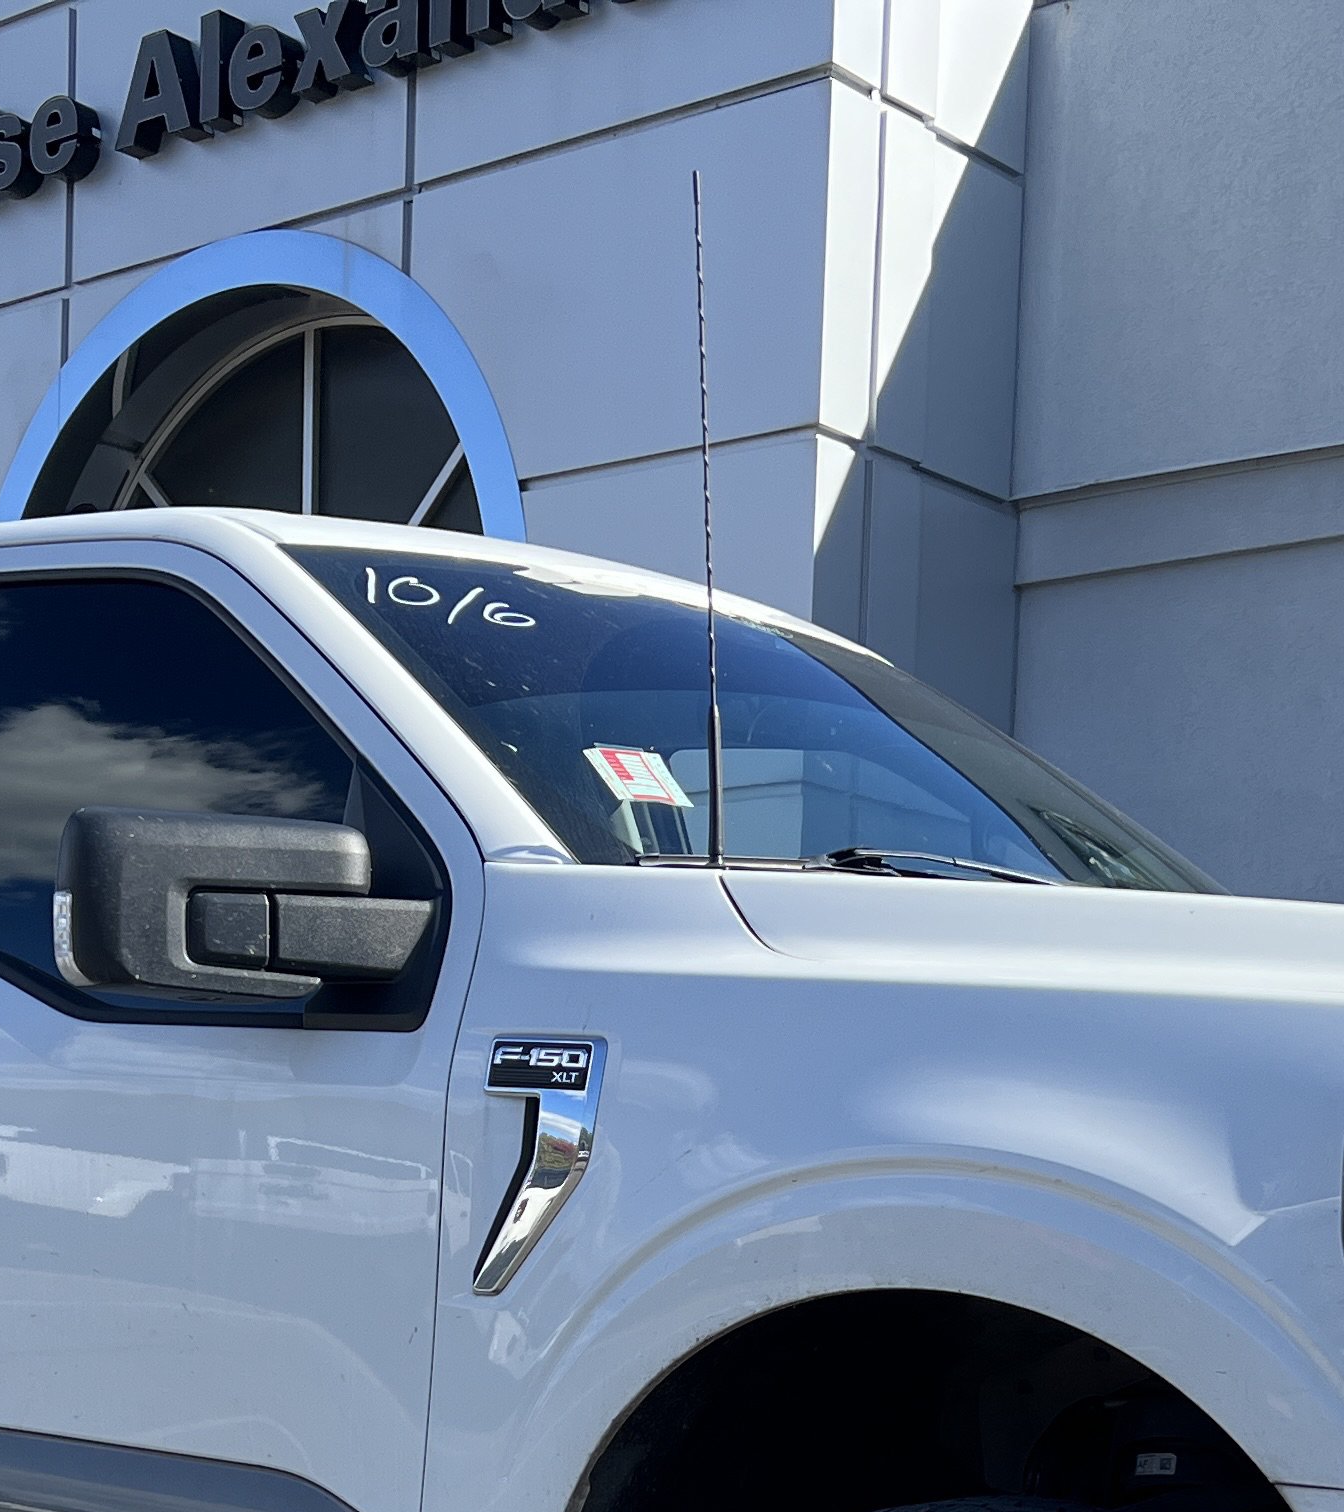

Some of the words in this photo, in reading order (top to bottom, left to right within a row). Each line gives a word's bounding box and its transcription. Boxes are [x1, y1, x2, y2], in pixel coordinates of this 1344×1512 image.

[114, 0, 646, 160] Alexa
[365, 567, 536, 627] 10/6
[493, 1045, 589, 1068] F-150
[550, 1071, 580, 1083] XLT
